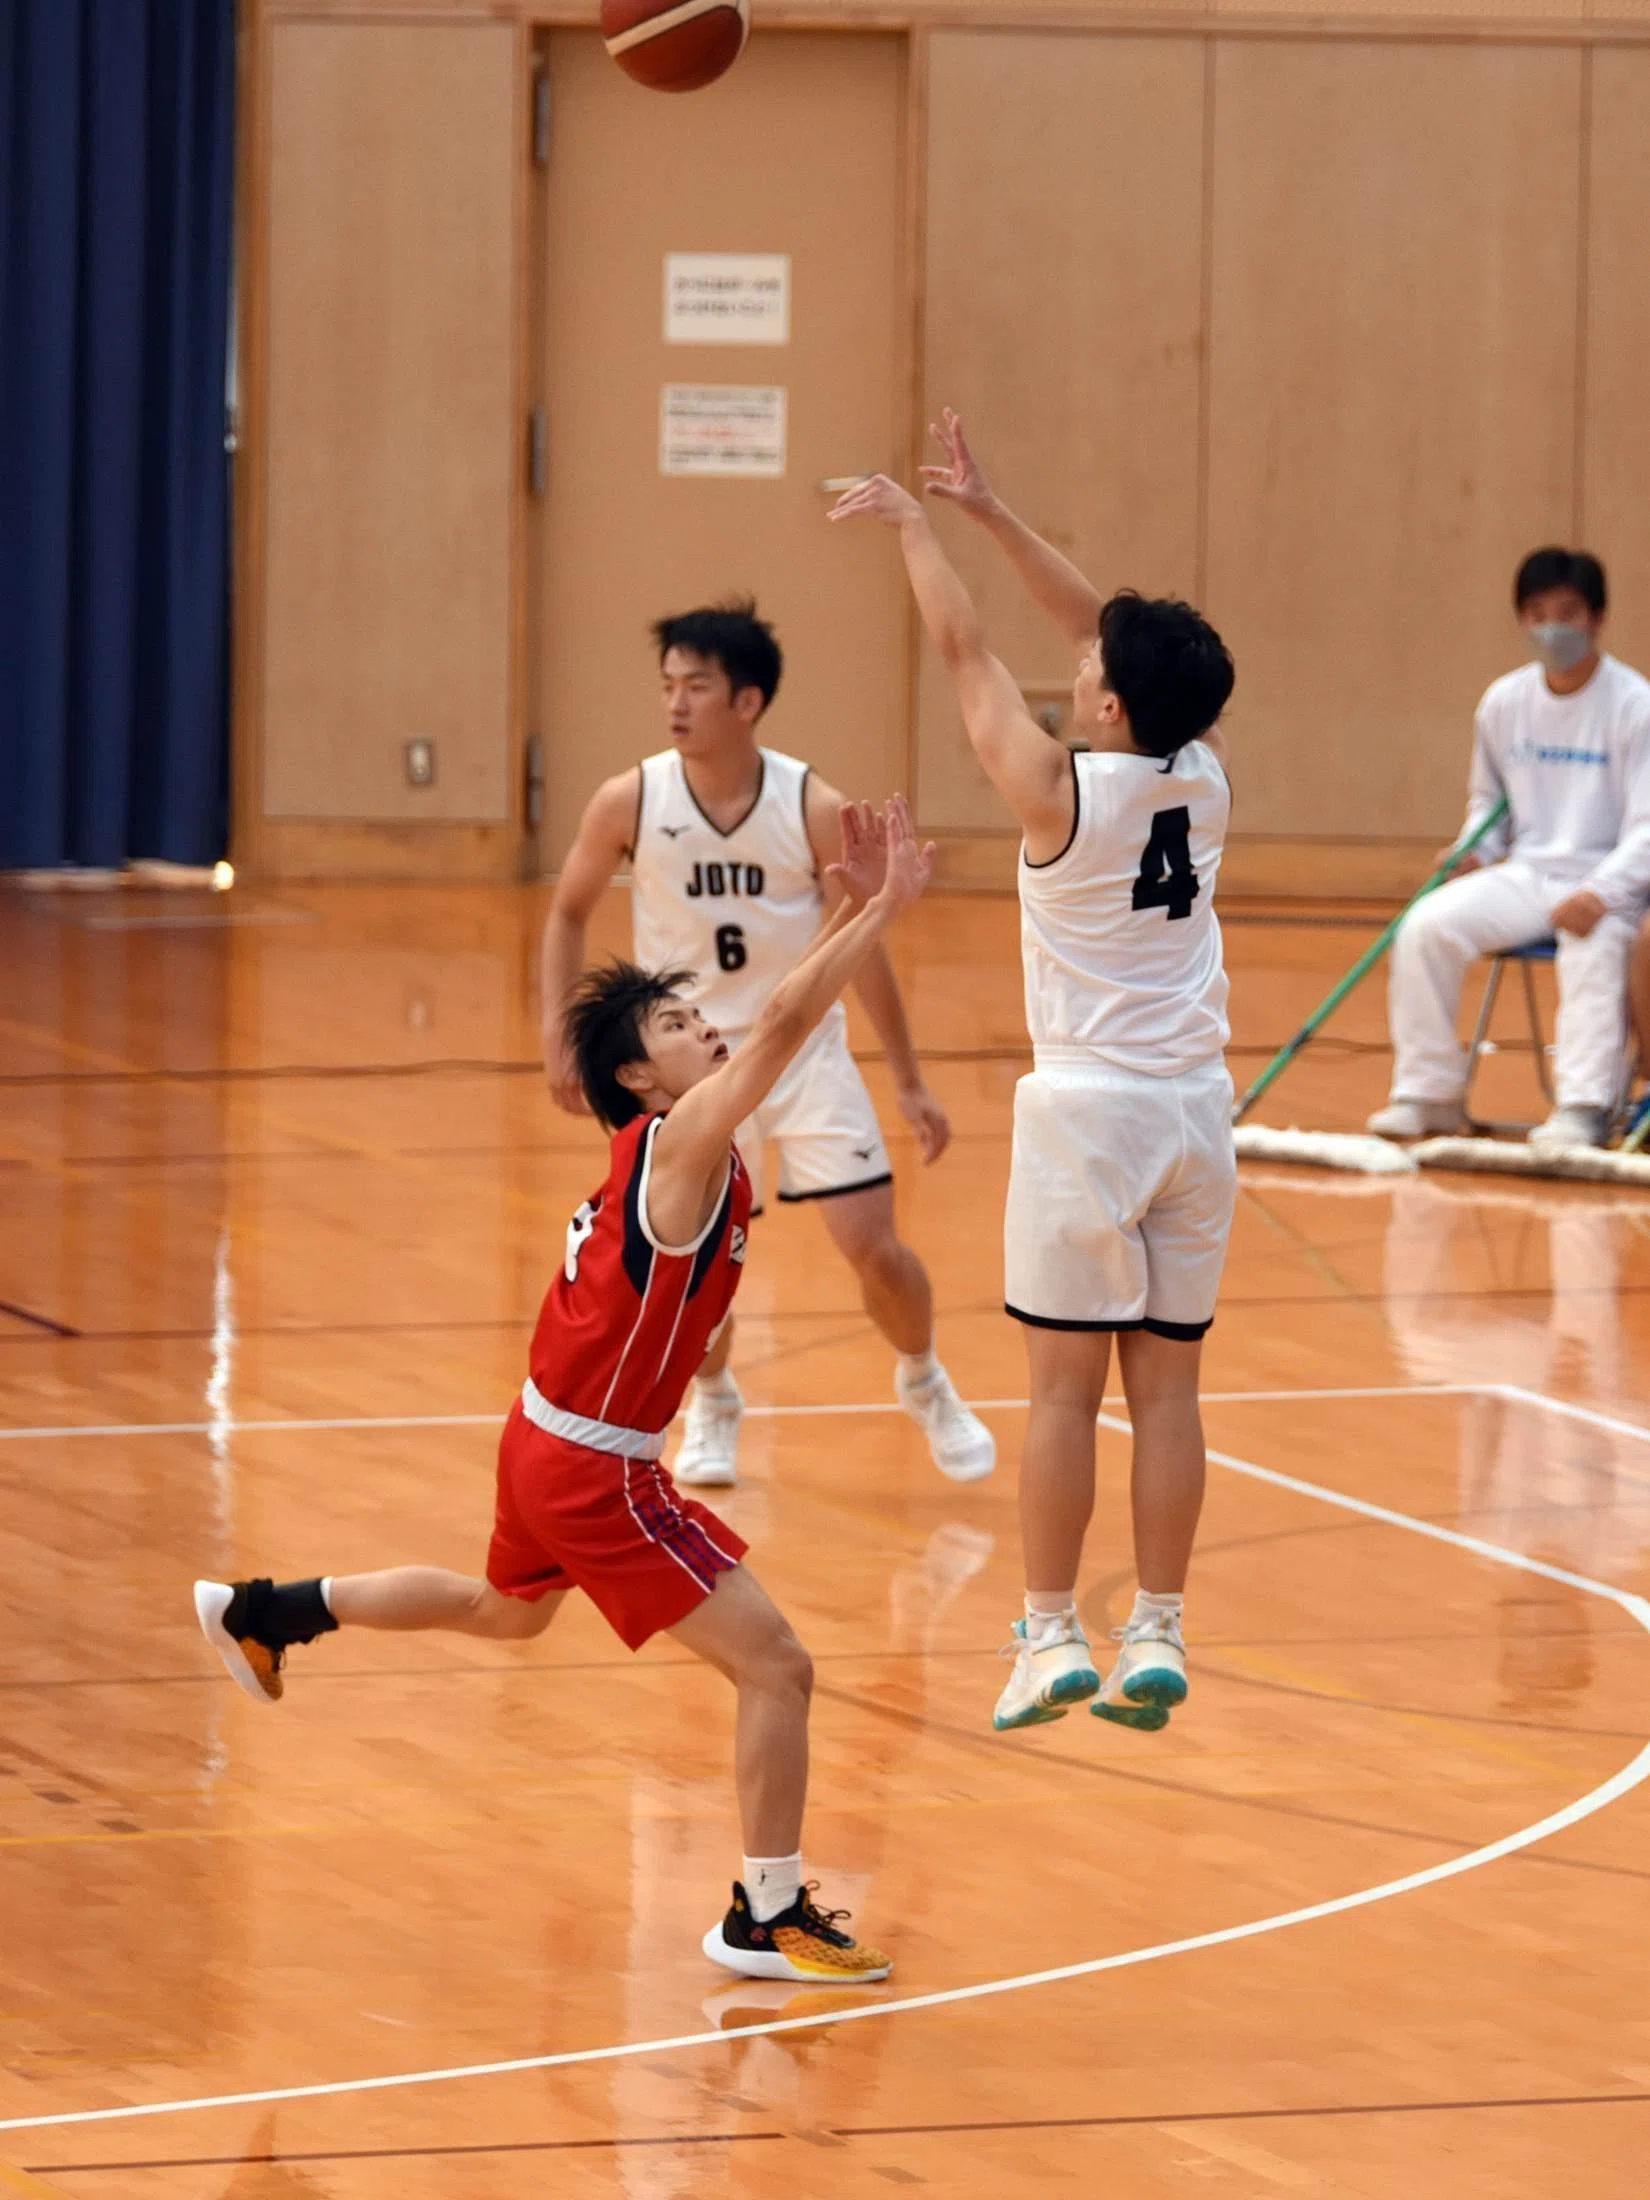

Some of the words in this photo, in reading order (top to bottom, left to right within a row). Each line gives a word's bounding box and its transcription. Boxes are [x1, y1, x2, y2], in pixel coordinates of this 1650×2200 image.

[686, 861, 764, 897] JOTO
[1132, 805, 1200, 921] 4
[715, 923, 747, 972] 6
